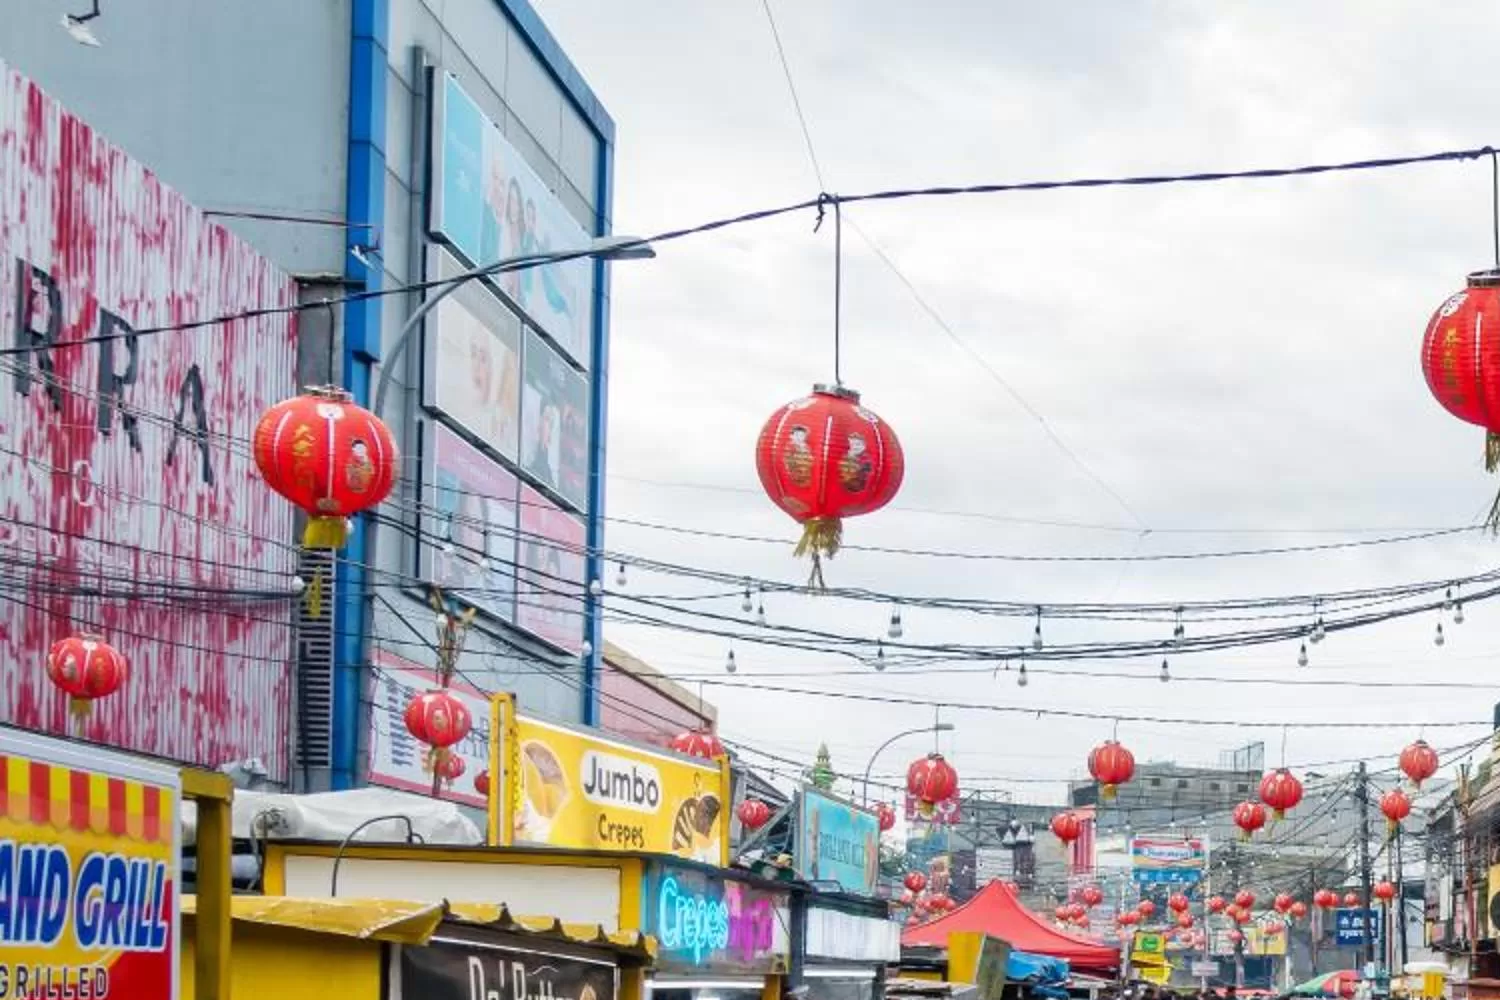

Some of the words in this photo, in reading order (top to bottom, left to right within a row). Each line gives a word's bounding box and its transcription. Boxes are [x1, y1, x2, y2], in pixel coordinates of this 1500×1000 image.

[584, 755, 661, 808] Jumbo
[598, 813, 645, 849] Crepes
[74, 852, 168, 951] GRILL
[659, 876, 729, 967] Crepes
[0, 964, 109, 1000] GRILLED
